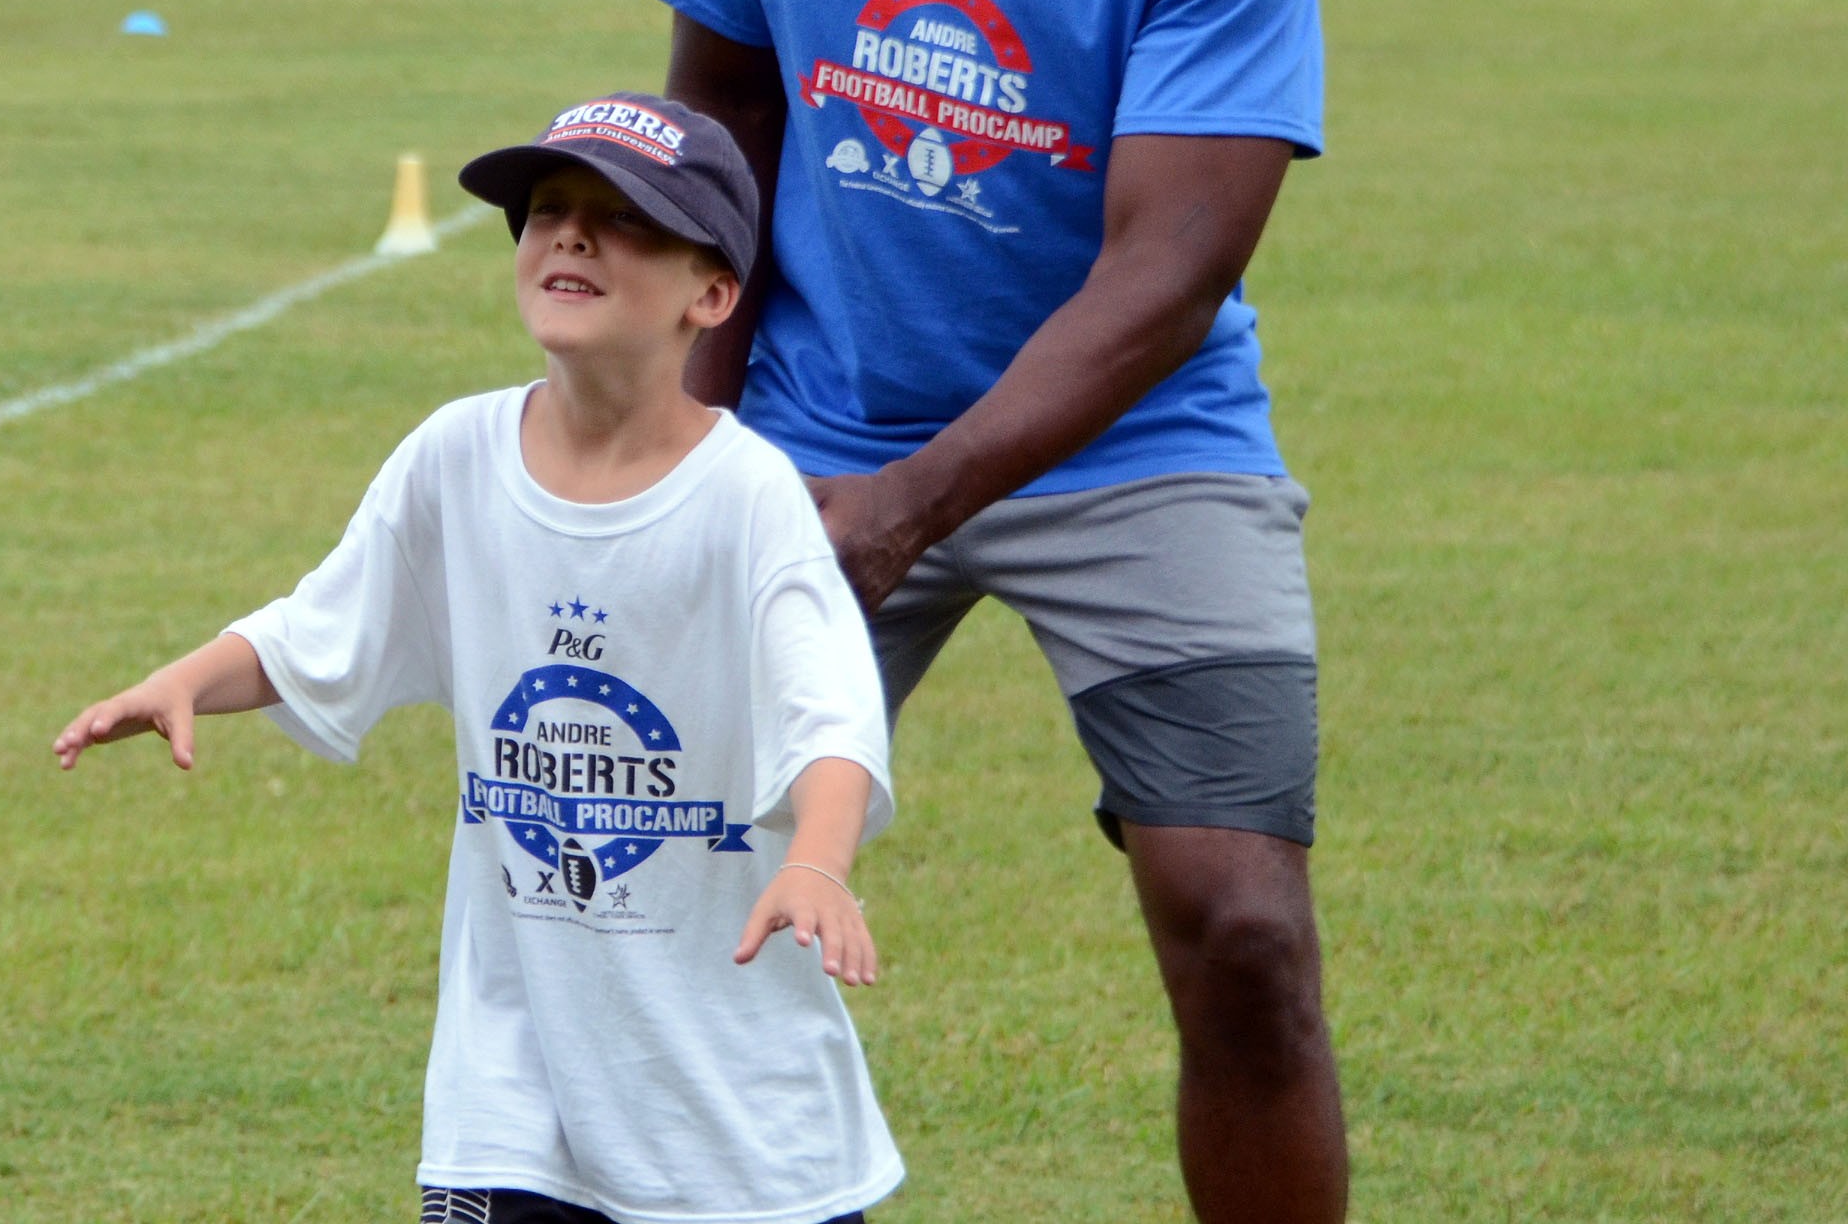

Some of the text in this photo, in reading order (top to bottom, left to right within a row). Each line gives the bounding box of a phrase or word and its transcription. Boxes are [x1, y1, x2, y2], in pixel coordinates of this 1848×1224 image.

[909, 18, 978, 55] ANDRE
[852, 29, 1028, 113] ROBERTS
[815, 64, 1065, 149] FOOTBALL PROCAMP
[552, 103, 684, 150] TIGERS
[596, 126, 675, 165] University
[547, 628, 606, 661] P&G
[536, 721, 612, 746] ANDRE
[576, 803, 717, 832] PROCAMP
